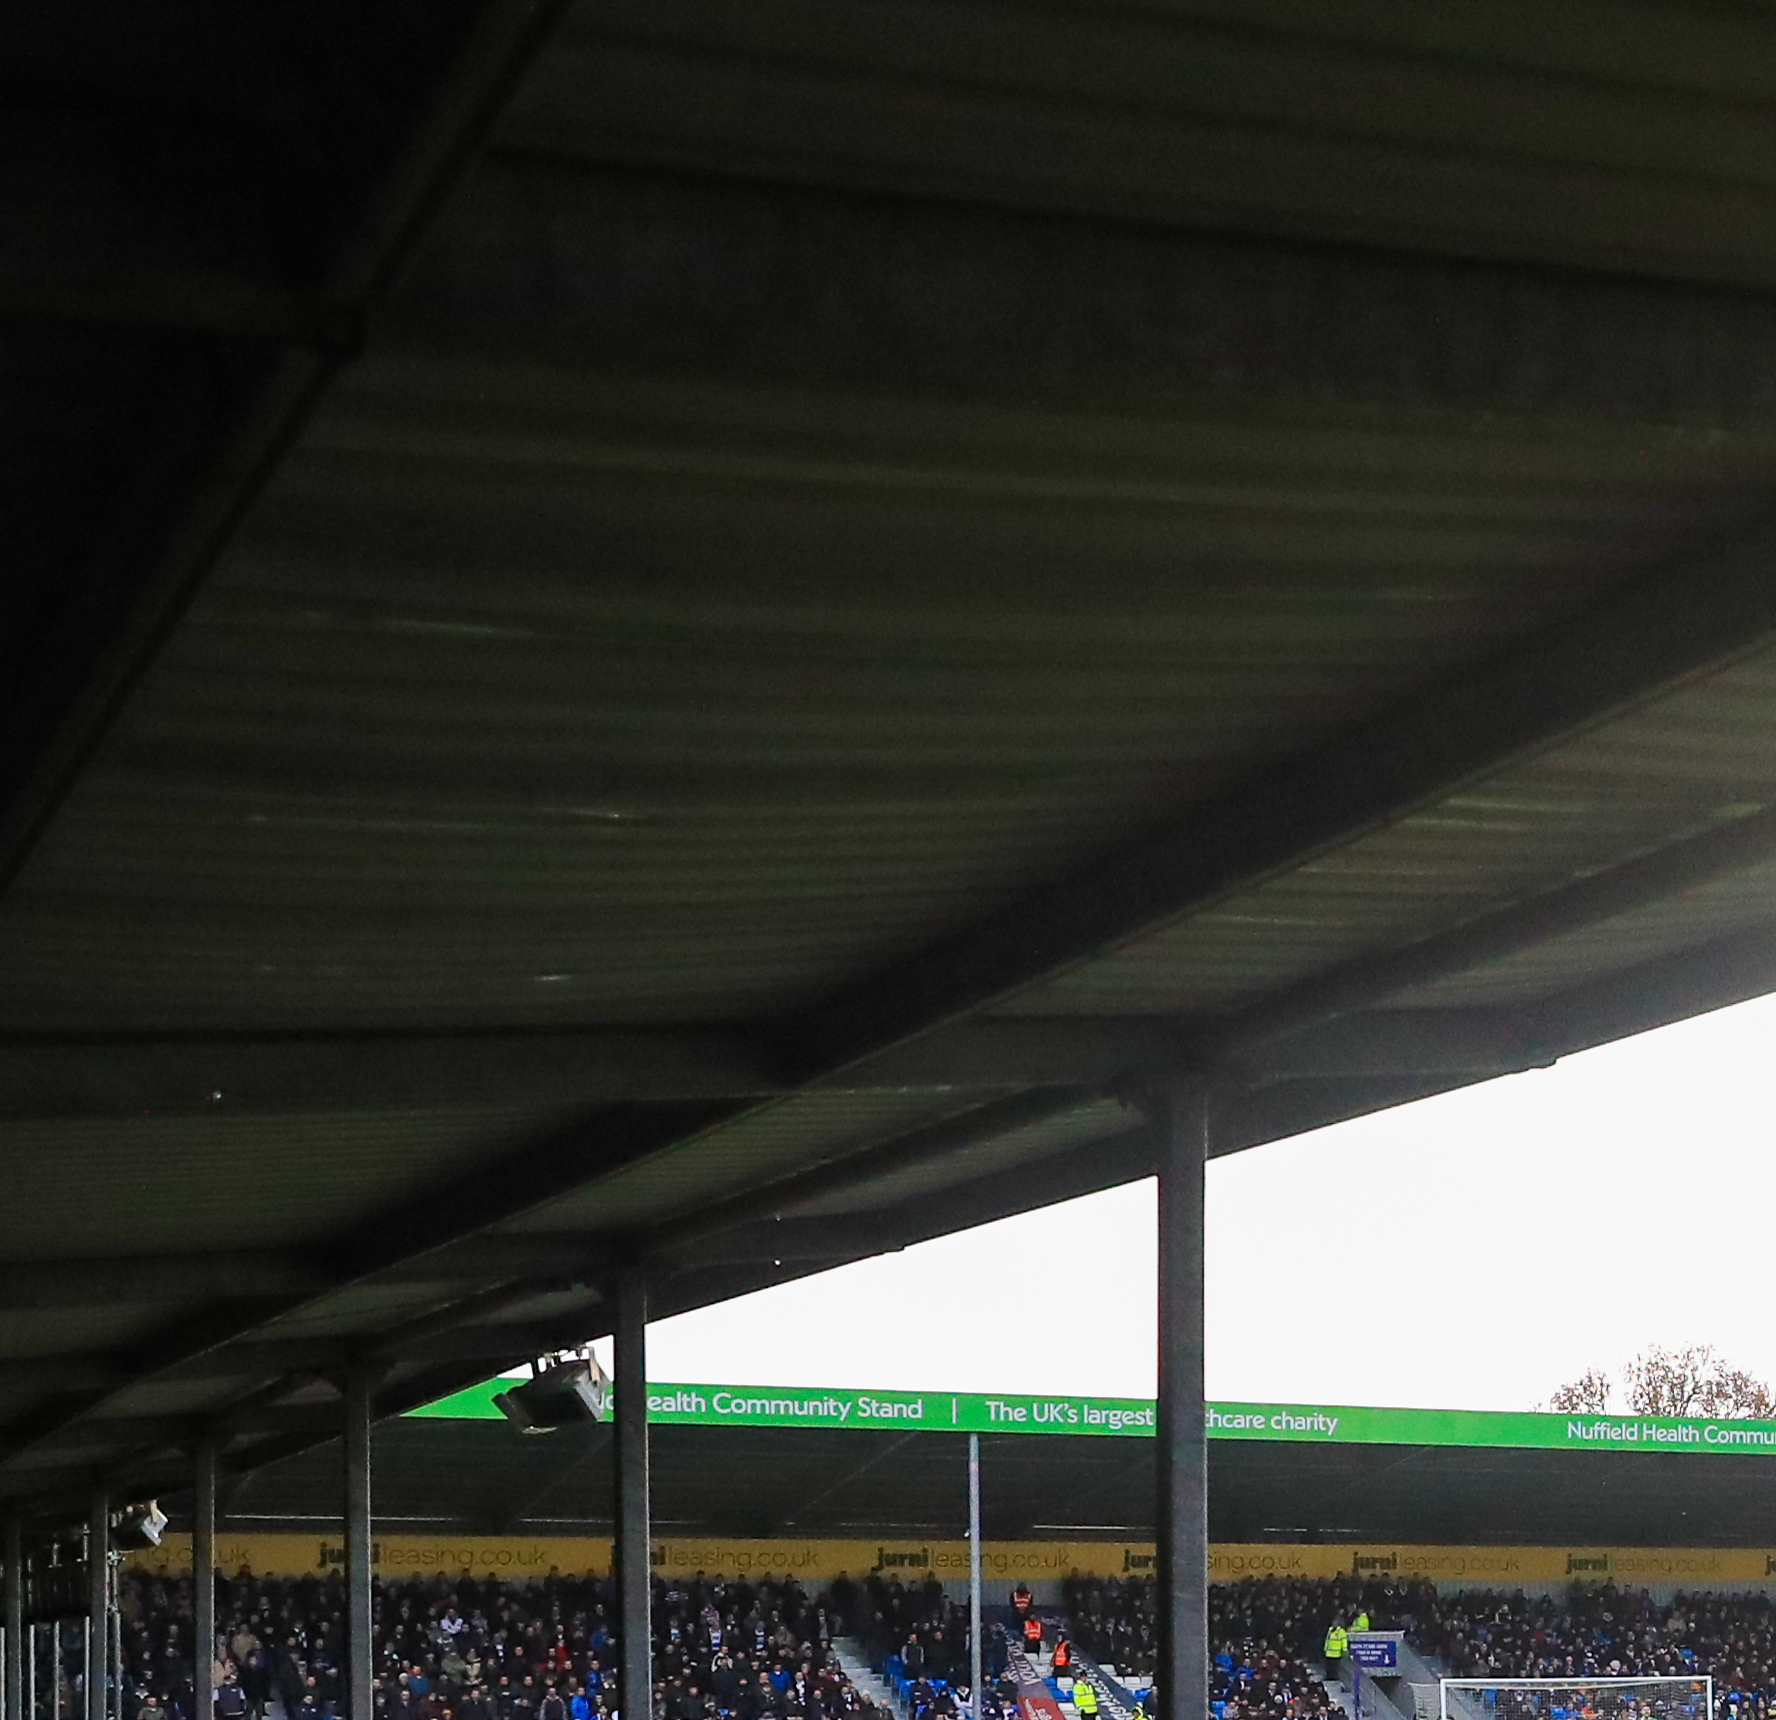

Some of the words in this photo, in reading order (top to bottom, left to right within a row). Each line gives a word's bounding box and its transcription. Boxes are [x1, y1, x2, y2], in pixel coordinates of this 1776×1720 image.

[645, 1390, 707, 1413] ealth
[713, 1393, 852, 1421] Community
[857, 1397, 923, 1419] Stand
[986, 1401, 1027, 1422] The
[1083, 1404, 1154, 1430] largest
[1270, 1411, 1339, 1436] charity
[1567, 1421, 1638, 1441] Nuffield
[1642, 1424, 1700, 1443] Health
